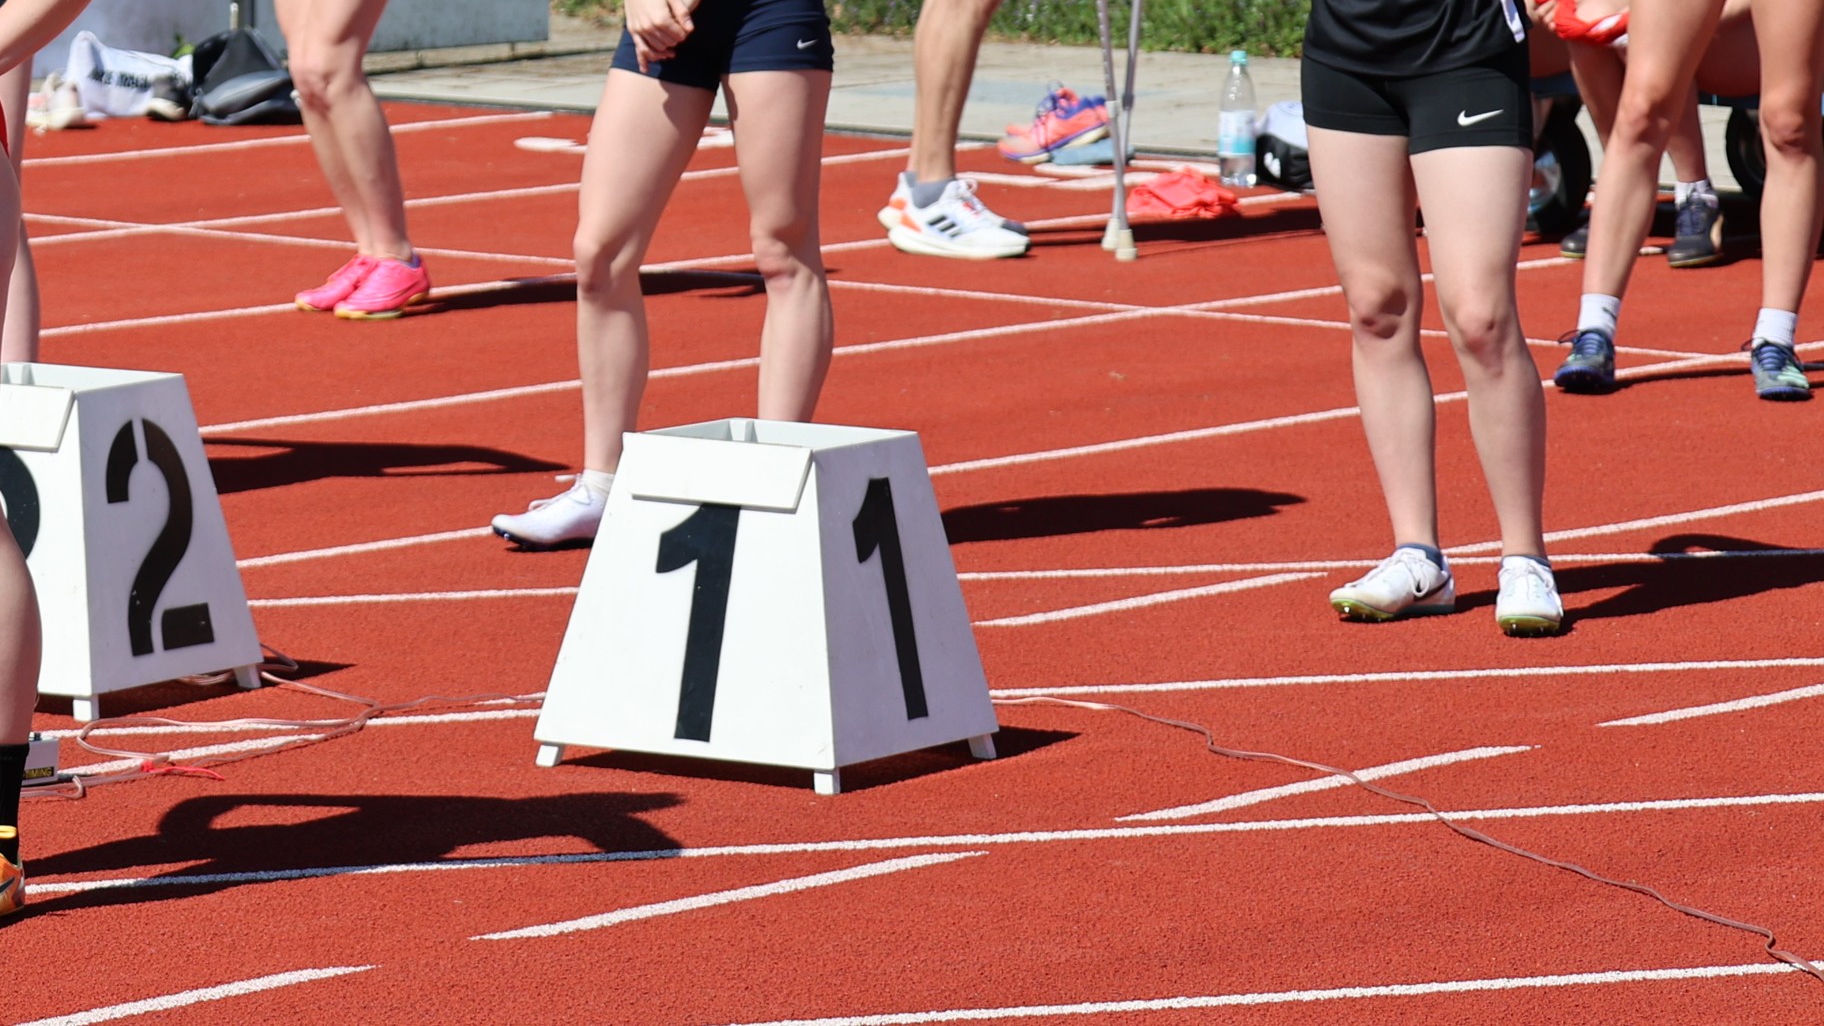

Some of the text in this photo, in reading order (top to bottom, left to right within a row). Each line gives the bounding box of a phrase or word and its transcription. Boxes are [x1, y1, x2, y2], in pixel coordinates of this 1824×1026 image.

[105, 417, 214, 657] 2
[655, 502, 741, 743] 1
[852, 476, 928, 720] 1
